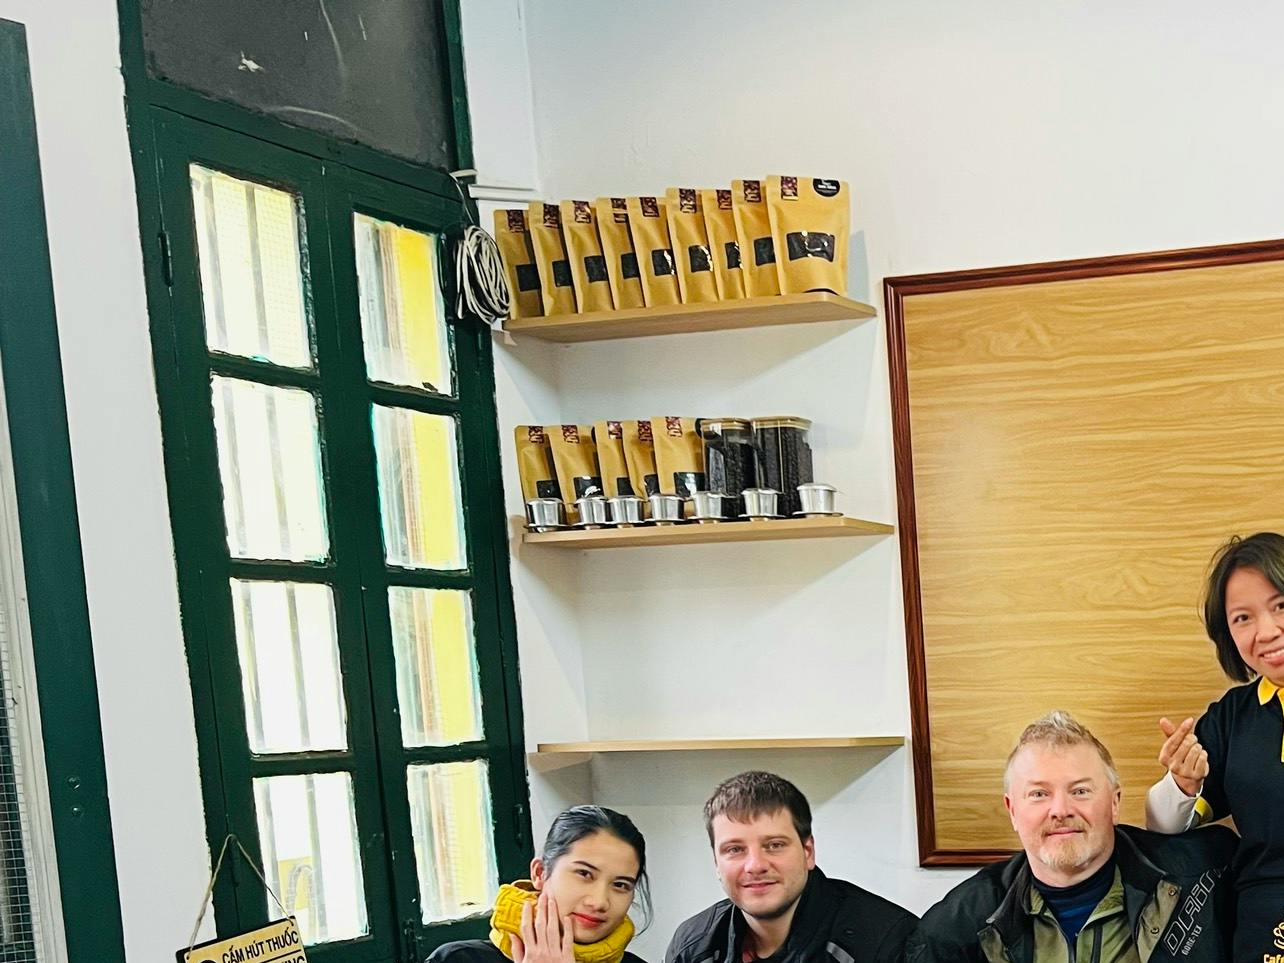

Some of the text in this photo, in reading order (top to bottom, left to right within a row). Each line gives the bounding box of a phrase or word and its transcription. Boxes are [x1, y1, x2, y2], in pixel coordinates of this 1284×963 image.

[246, 940, 265, 959] HÚT
[266, 927, 299, 952] THUỐC
[1182, 925, 1202, 955] GORE-TEX
